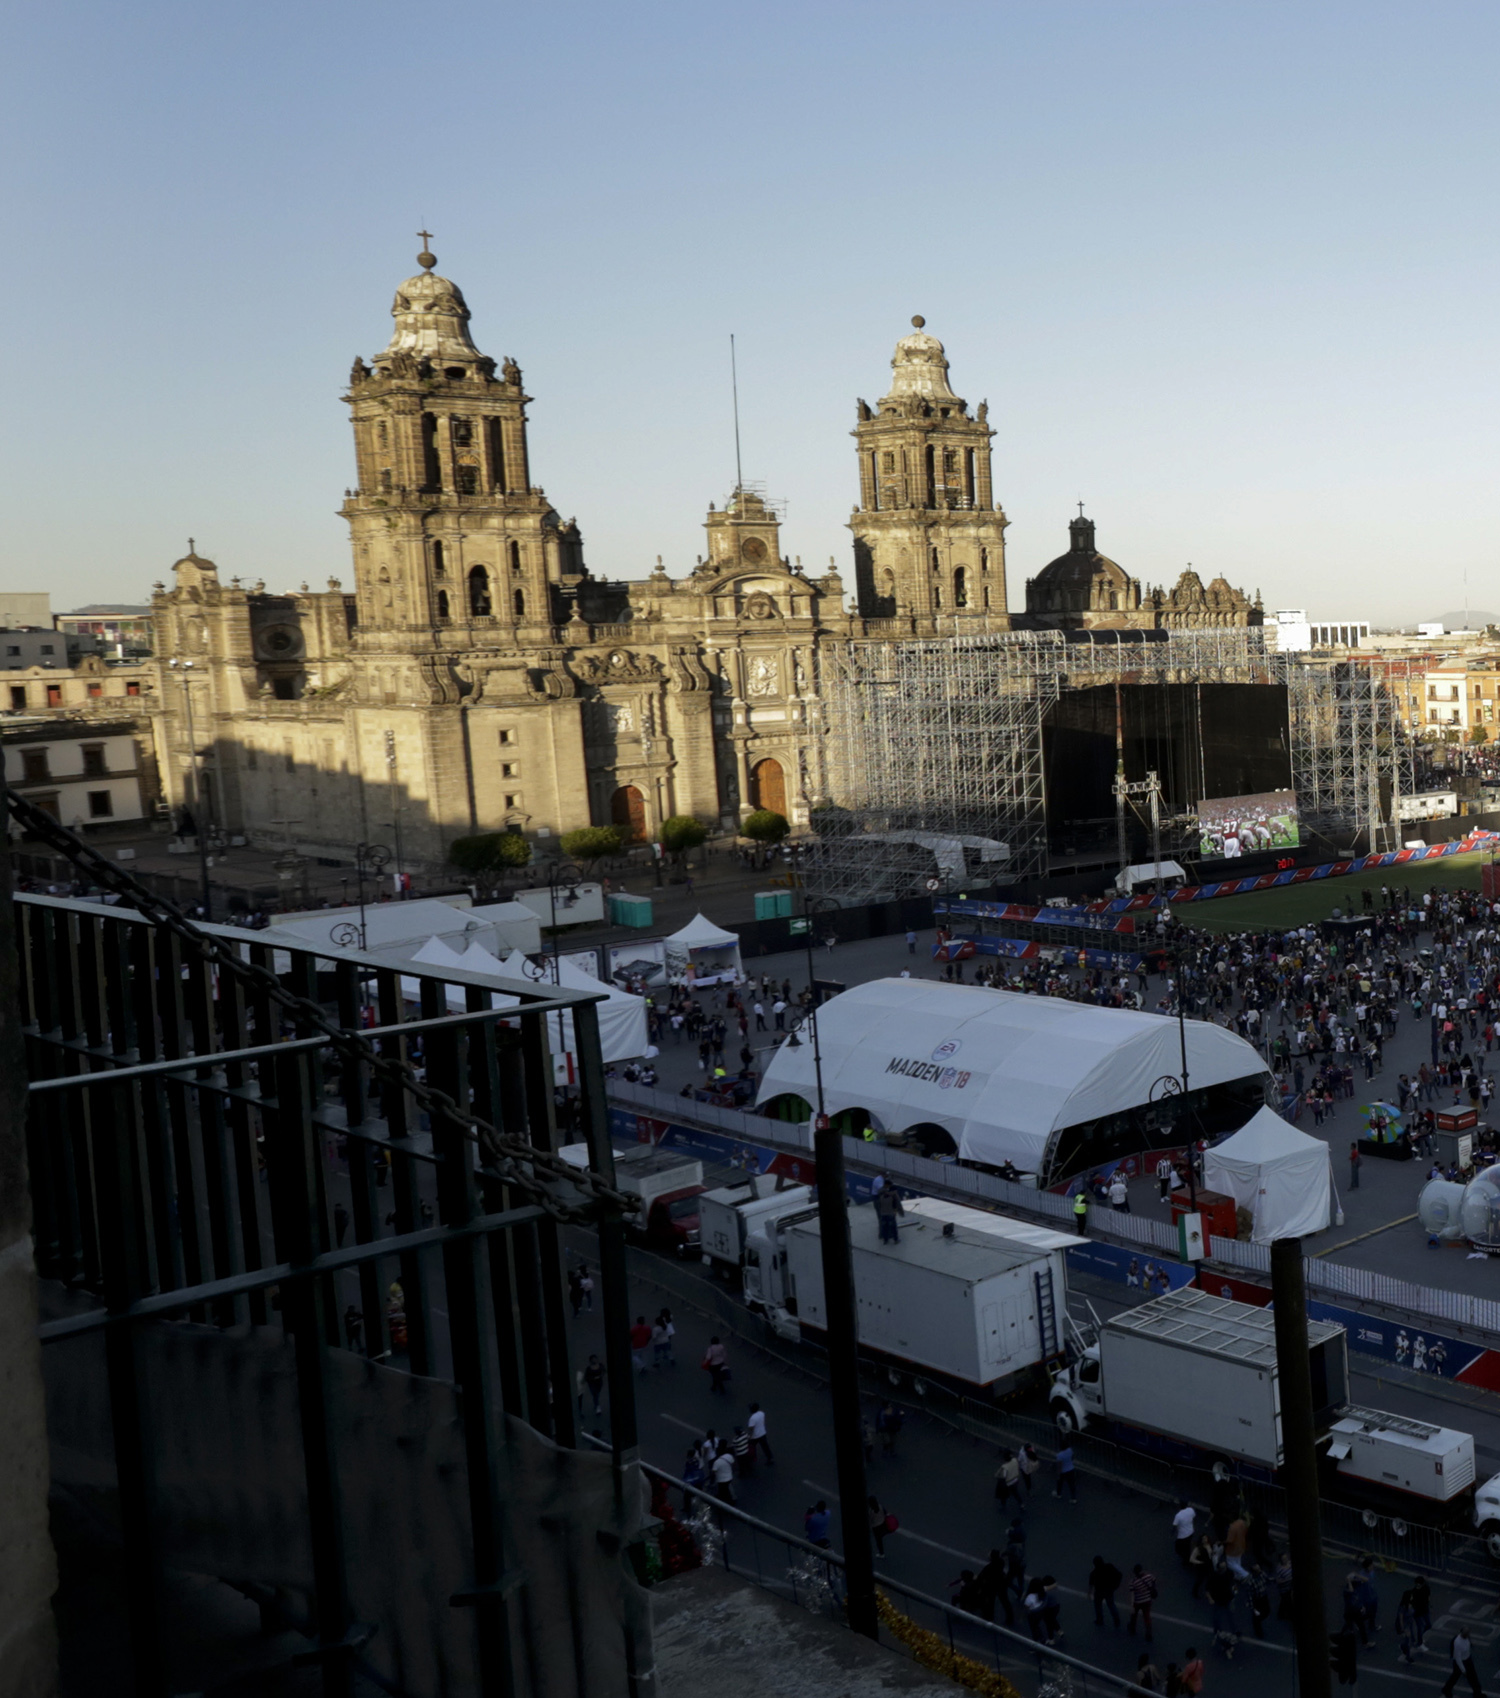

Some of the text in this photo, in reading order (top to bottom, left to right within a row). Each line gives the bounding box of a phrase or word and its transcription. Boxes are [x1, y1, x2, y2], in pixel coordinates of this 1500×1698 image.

[1223, 820, 1237, 834] 37
[940, 1043, 956, 1053] EA
[885, 1057, 945, 1083] MADDEN
[953, 1070, 971, 1088] 18
